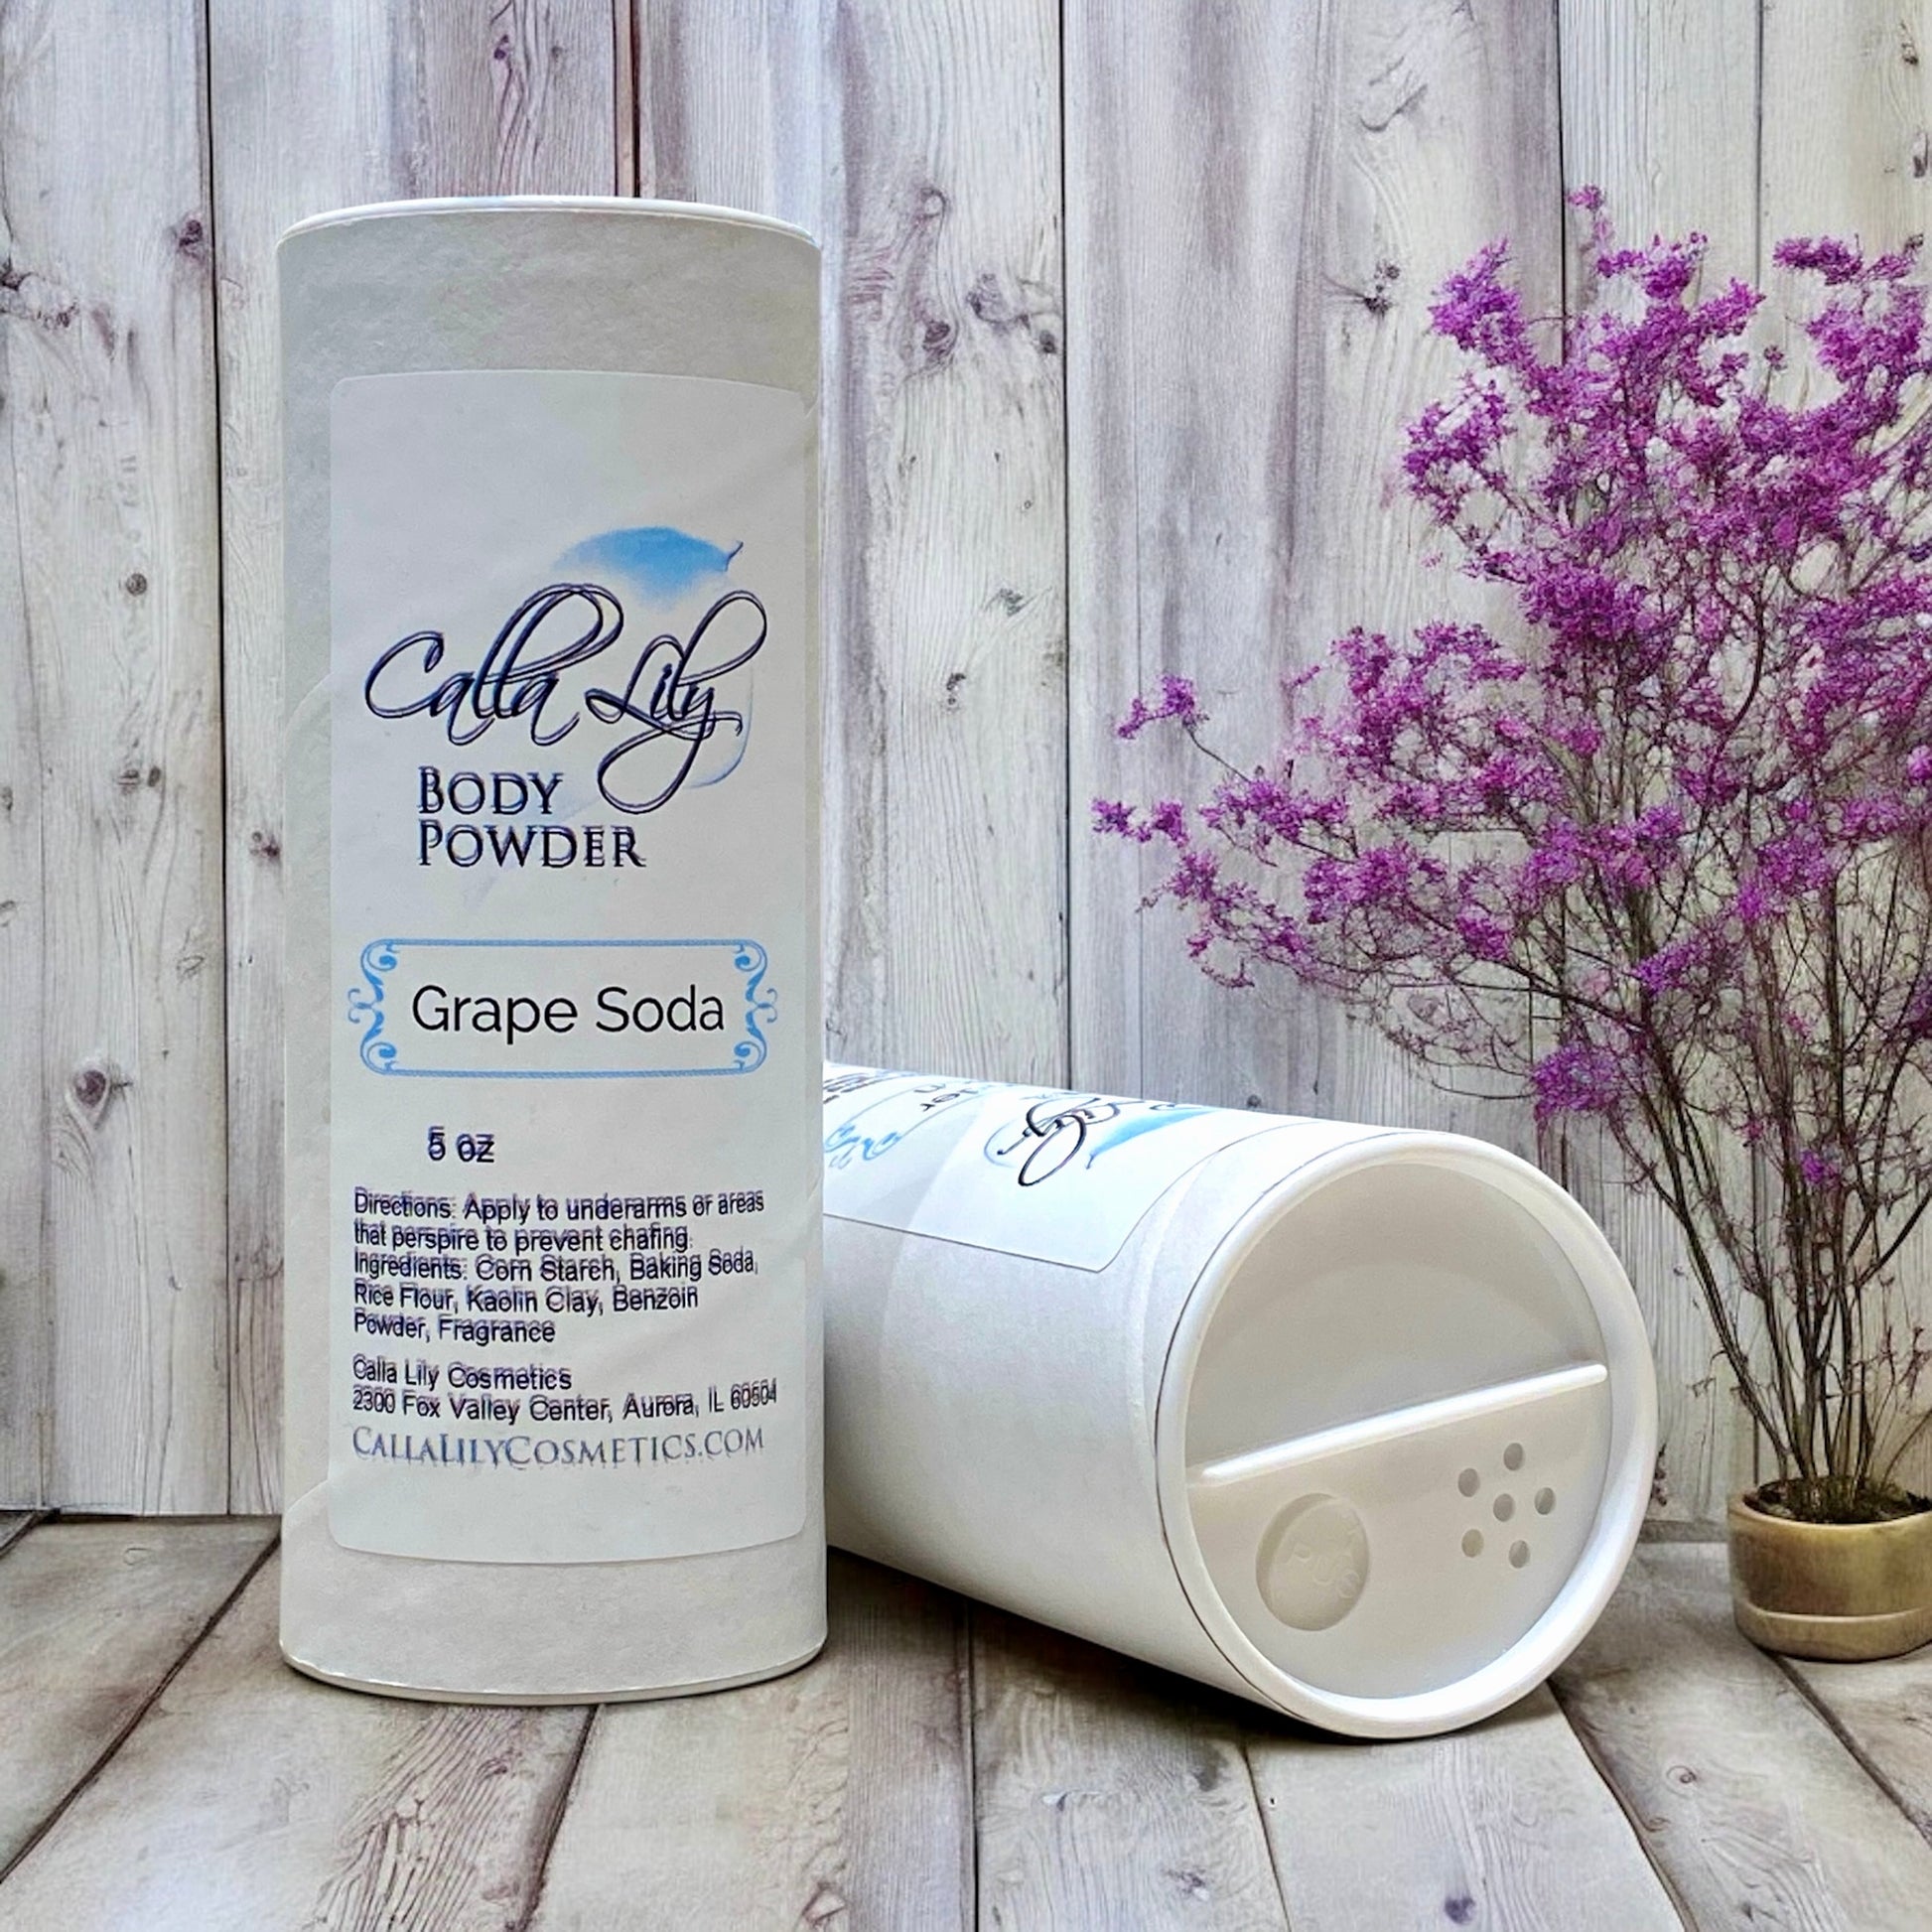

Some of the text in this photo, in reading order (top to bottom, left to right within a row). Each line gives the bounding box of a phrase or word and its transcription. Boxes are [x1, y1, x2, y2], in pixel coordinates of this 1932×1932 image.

[364, 583, 767, 814] Calla Lily
[412, 984, 725, 1045] Grape Soda
[427, 1126, 496, 1164] 5 oz
[354, 1187, 764, 1225] Directions: Apply to underarms or areas
[354, 1217, 694, 1256] that perspire to prevent chafing.
[354, 1246, 759, 1284] Ingredients: Corn Starch, Baking Soda,
[354, 1277, 699, 1317] Rice Flour, Kaolin Clay, Benzoin
[354, 1307, 556, 1346] Powder, Fragrance
[352, 1353, 573, 1391] Calla Lily Cosmetics
[352, 1384, 396, 1414] 2300
[402, 1390, 441, 1419] Fox
[448, 1392, 520, 1426] Valley
[529, 1394, 614, 1424] Center,
[621, 1392, 701, 1420] Aurora,
[708, 1385, 726, 1413] IL
